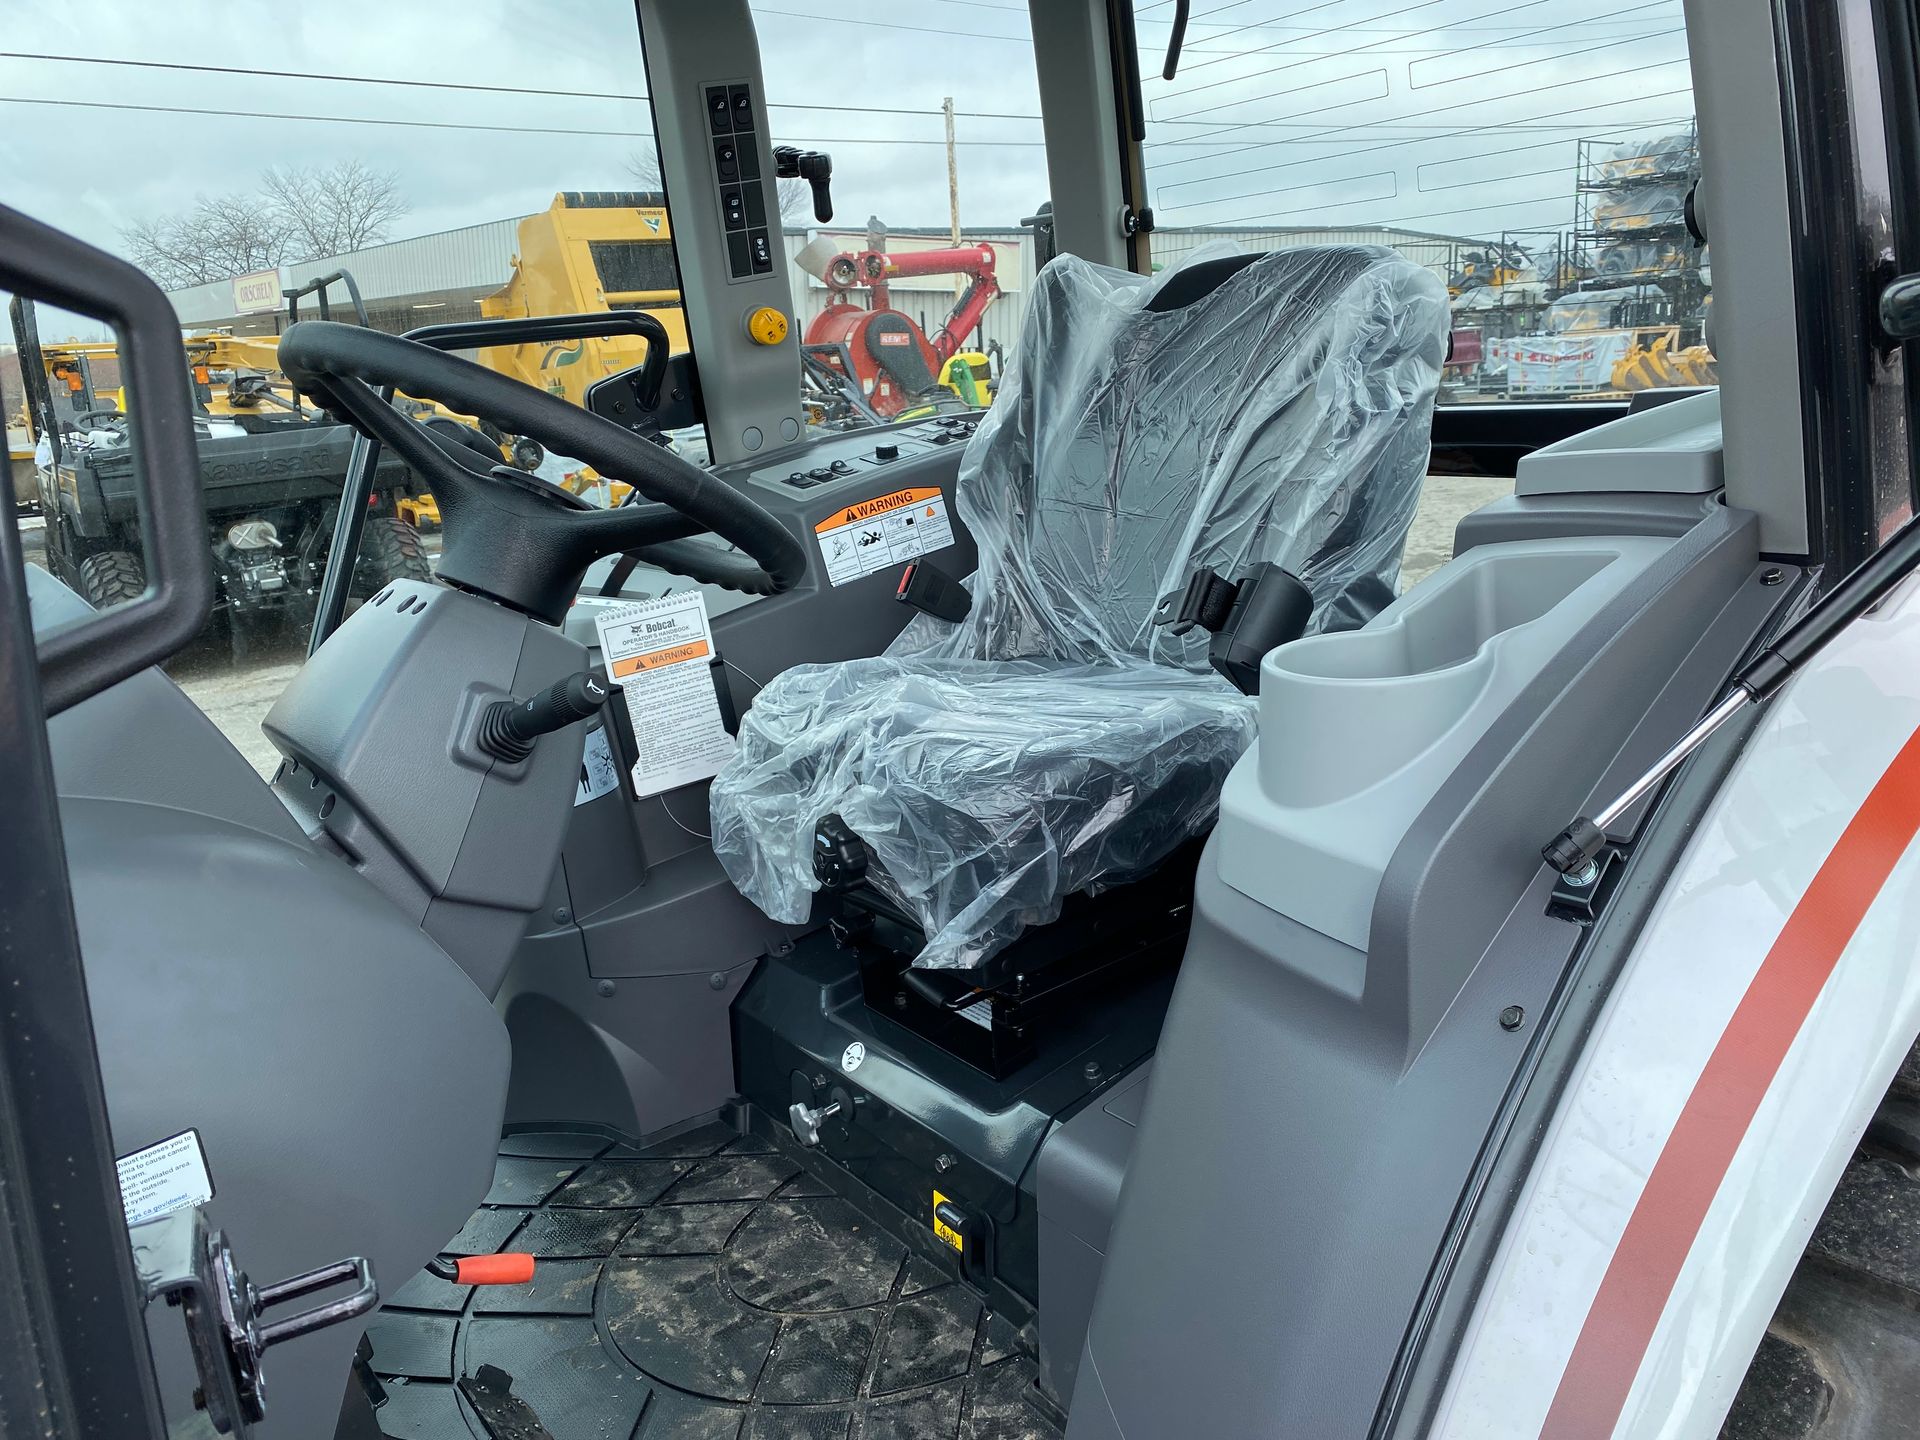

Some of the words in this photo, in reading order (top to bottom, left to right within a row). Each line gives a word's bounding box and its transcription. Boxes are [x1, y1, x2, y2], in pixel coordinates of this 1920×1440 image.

[240, 281, 275, 303] ORSCHELN
[857, 491, 913, 517] WARNING
[622, 632, 658, 646] OPERATOR'S
[660, 625, 690, 637] HANDBOOK
[646, 618, 676, 633] Bobcat
[649, 647, 693, 664] WARNING
[117, 1156, 139, 1169] haust
[139, 1145, 169, 1160] exposes
[170, 1139, 183, 1149] you
[117, 1167, 136, 1177] ornia
[145, 1154, 166, 1166] cause
[140, 1167, 174, 1184] ventilated
[175, 1161, 192, 1171] area.
[128, 1190, 140, 1198] the
